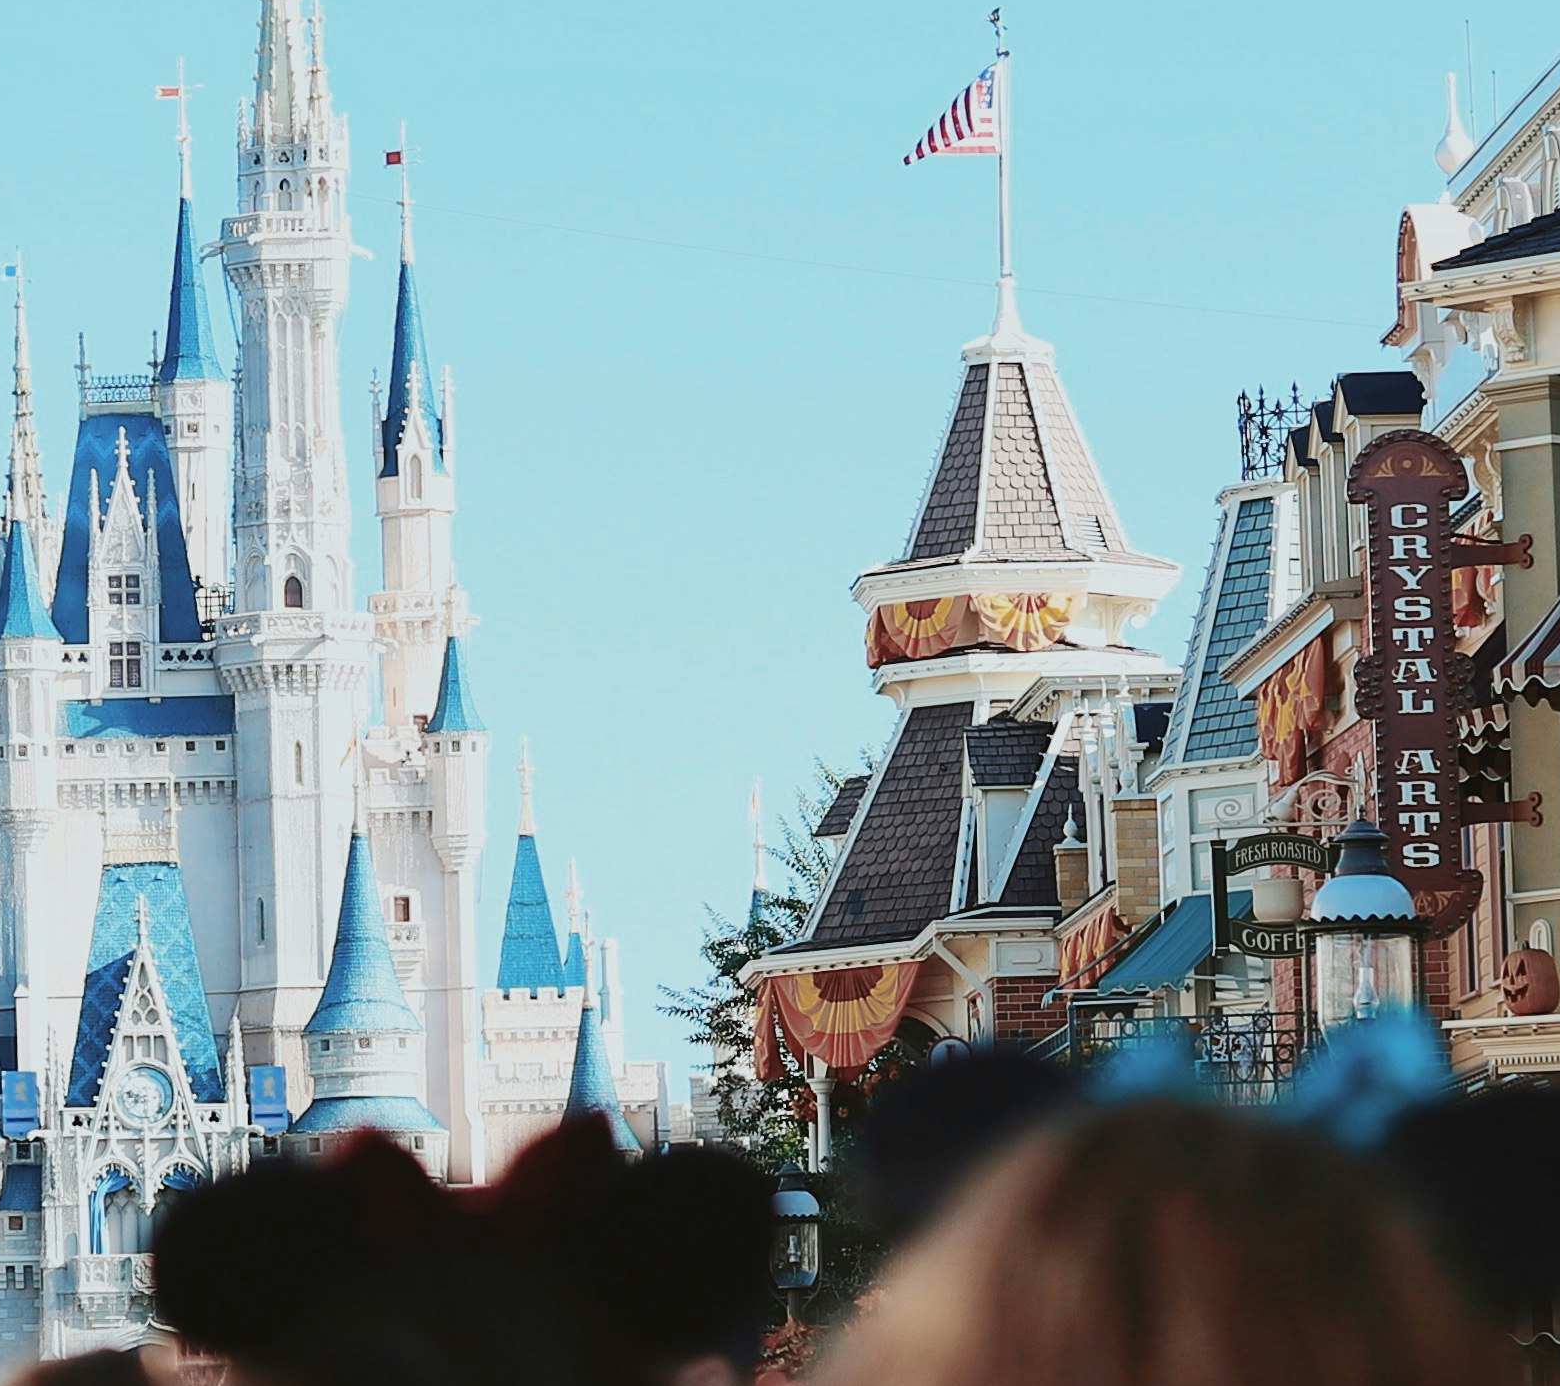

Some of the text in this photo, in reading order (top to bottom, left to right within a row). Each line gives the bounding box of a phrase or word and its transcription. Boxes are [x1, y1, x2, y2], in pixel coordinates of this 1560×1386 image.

[1388, 503, 1441, 869] CRYSTAL ARTS
[1235, 841, 1322, 868] FRESH ROASTED
[1241, 928, 1315, 952] COFFE
